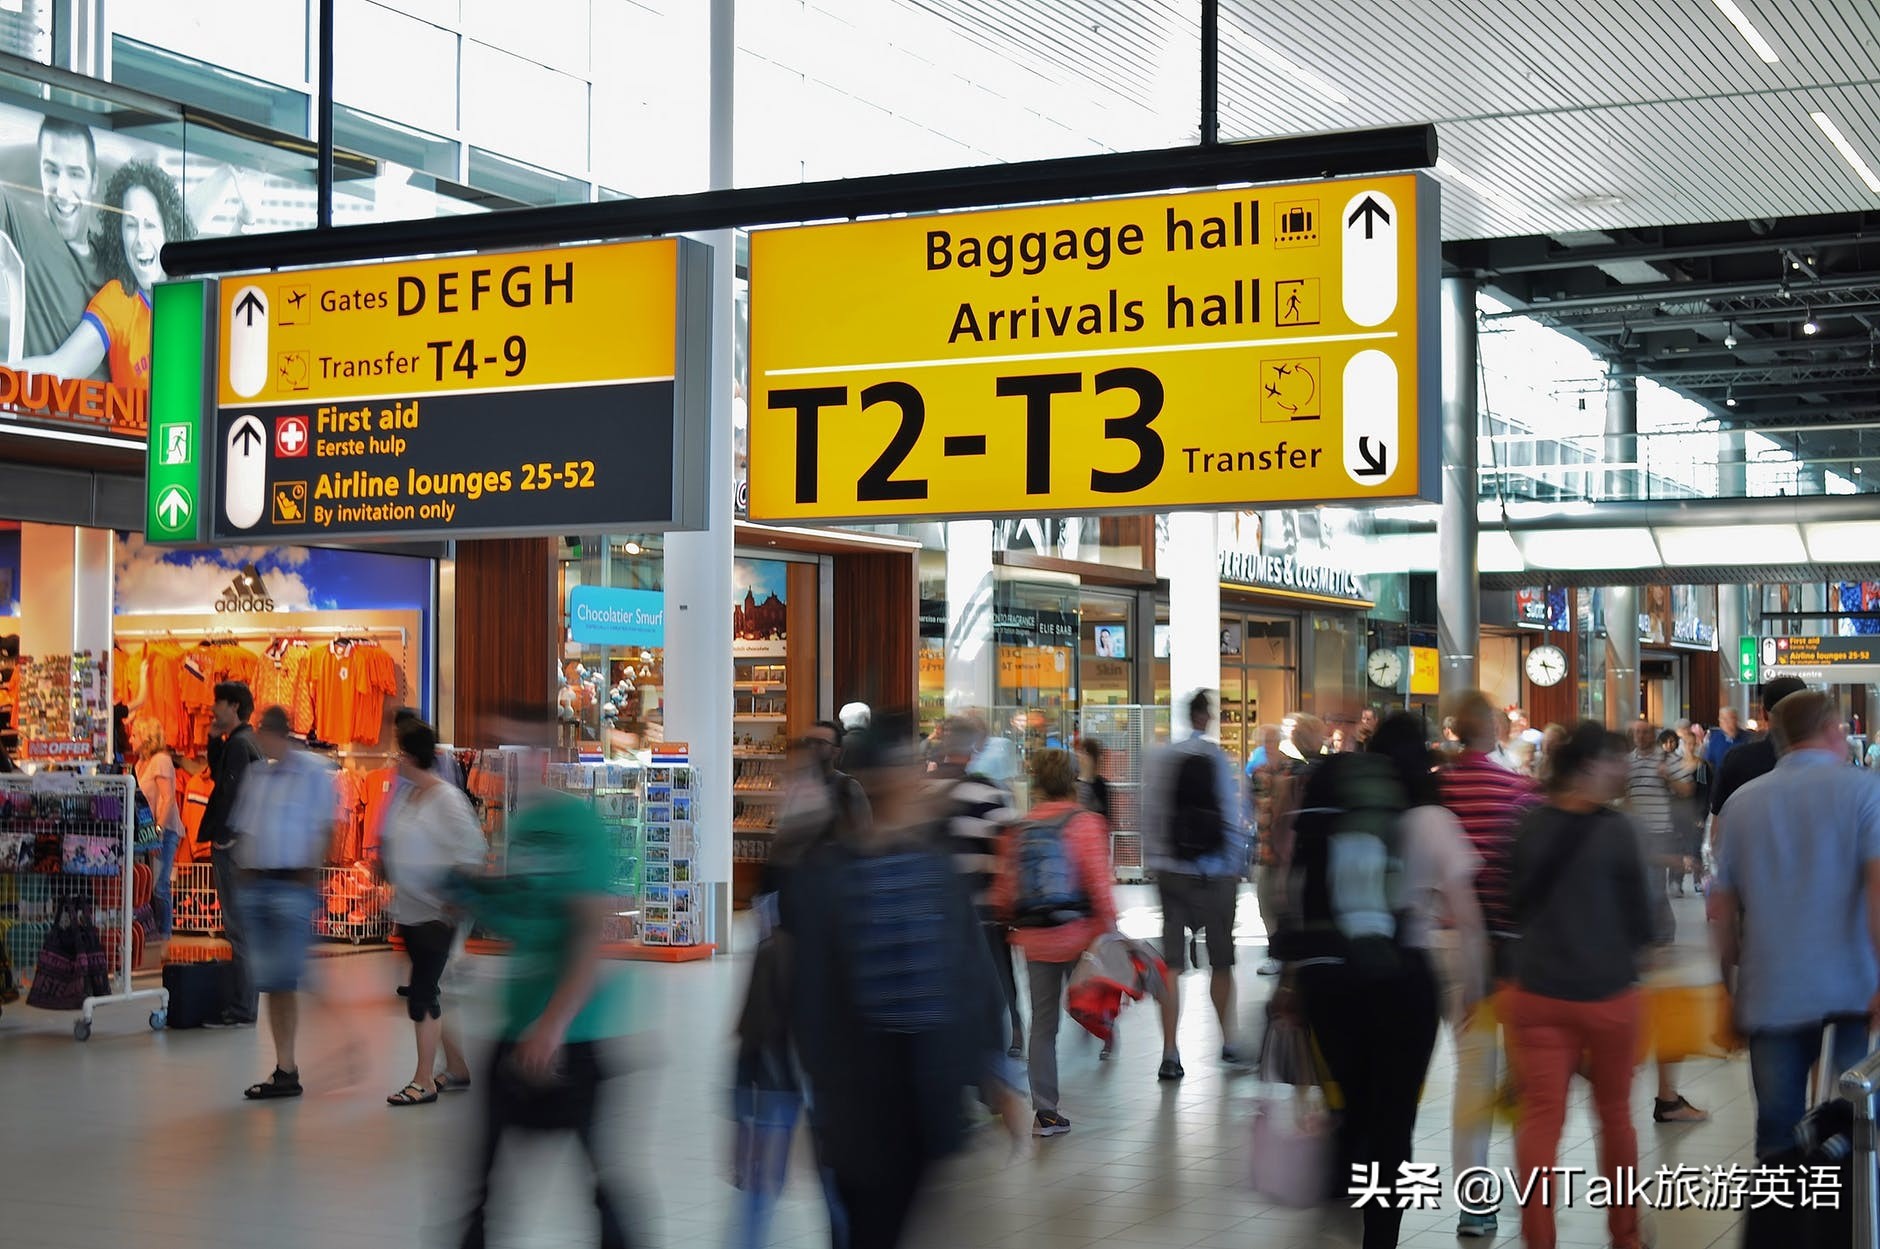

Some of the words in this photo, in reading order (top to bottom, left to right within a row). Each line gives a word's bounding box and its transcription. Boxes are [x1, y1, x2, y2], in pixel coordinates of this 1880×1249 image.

[926, 222, 1144, 277] Baggage
[1166, 200, 1259, 252] hall
[320, 290, 388, 312] Gates
[948, 290, 1145, 344] Arrivals
[1167, 278, 1260, 329] hall
[319, 351, 420, 379] Transfer
[427, 335, 526, 381] T4-9
[317, 406, 372, 433] First
[379, 400, 419, 430] aid
[317, 438, 364, 457] Eerste
[370, 435, 406, 457] hulp
[768, 367, 1165, 503] T2-T3
[1182, 442, 1322, 474] Transfer
[314, 470, 399, 499] Airline
[408, 468, 512, 500] lounges
[520, 460, 595, 490] 25-52
[314, 505, 333, 527] By
[338, 502, 414, 522] invitation
[419, 499, 455, 522] only
[1296, 564, 1358, 594] COSMETICS
[215, 594, 274, 612] adidas
[577, 604, 633, 624] Chocolatier
[1039, 623, 1055, 634] ELIE
[1055, 625, 1072, 636] SAAB
